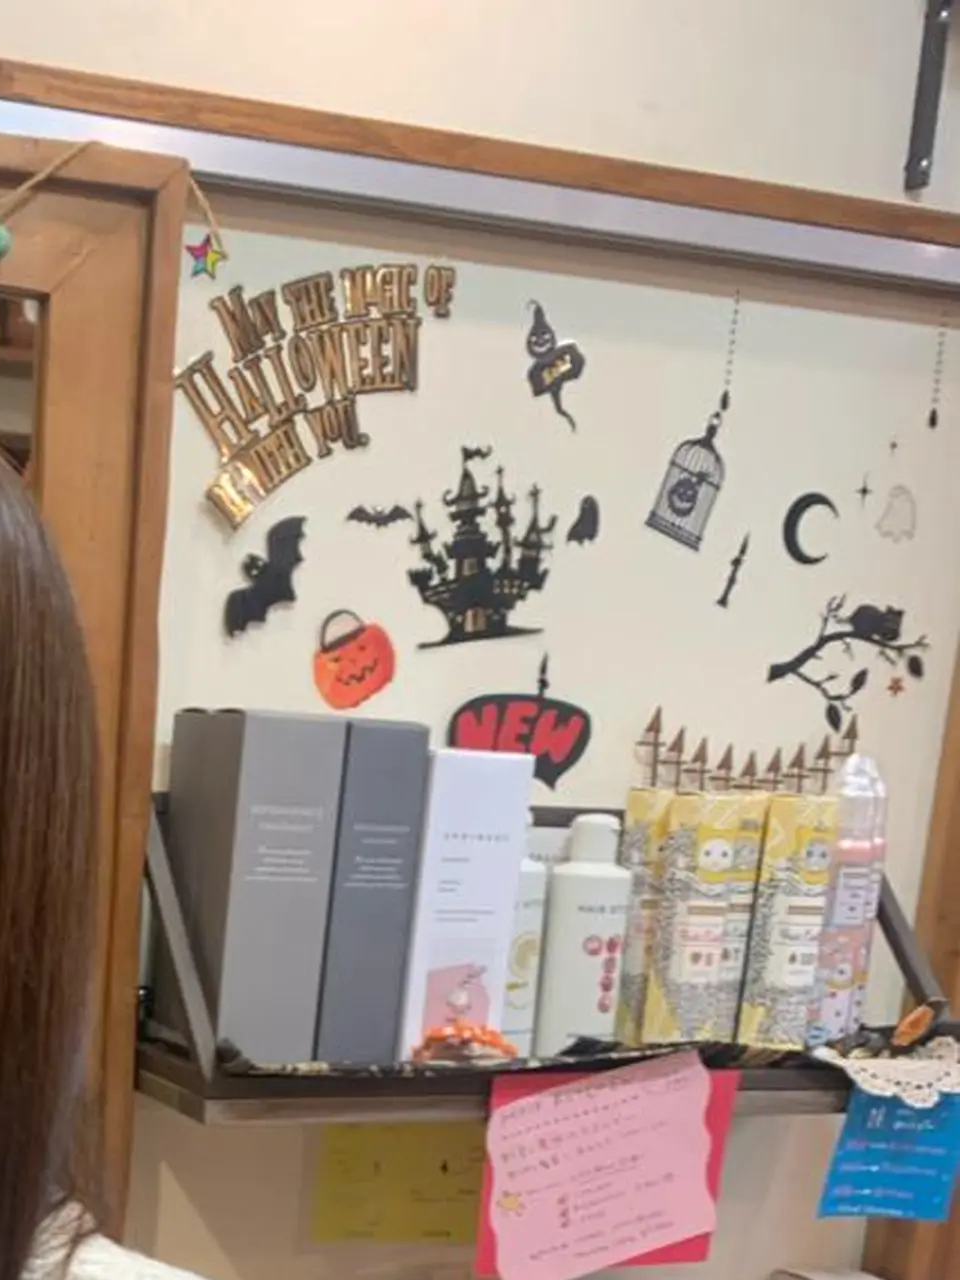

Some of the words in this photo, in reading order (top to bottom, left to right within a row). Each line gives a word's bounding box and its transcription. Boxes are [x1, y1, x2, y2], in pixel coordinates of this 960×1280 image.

[281, 270, 338, 333] THE
[339, 263, 418, 319] MAGIC
[424, 264, 456, 318] OF
[174, 316, 422, 464] HALLOWEEN
[230, 418, 312, 496] WITH
[457, 700, 586, 764] NEW
